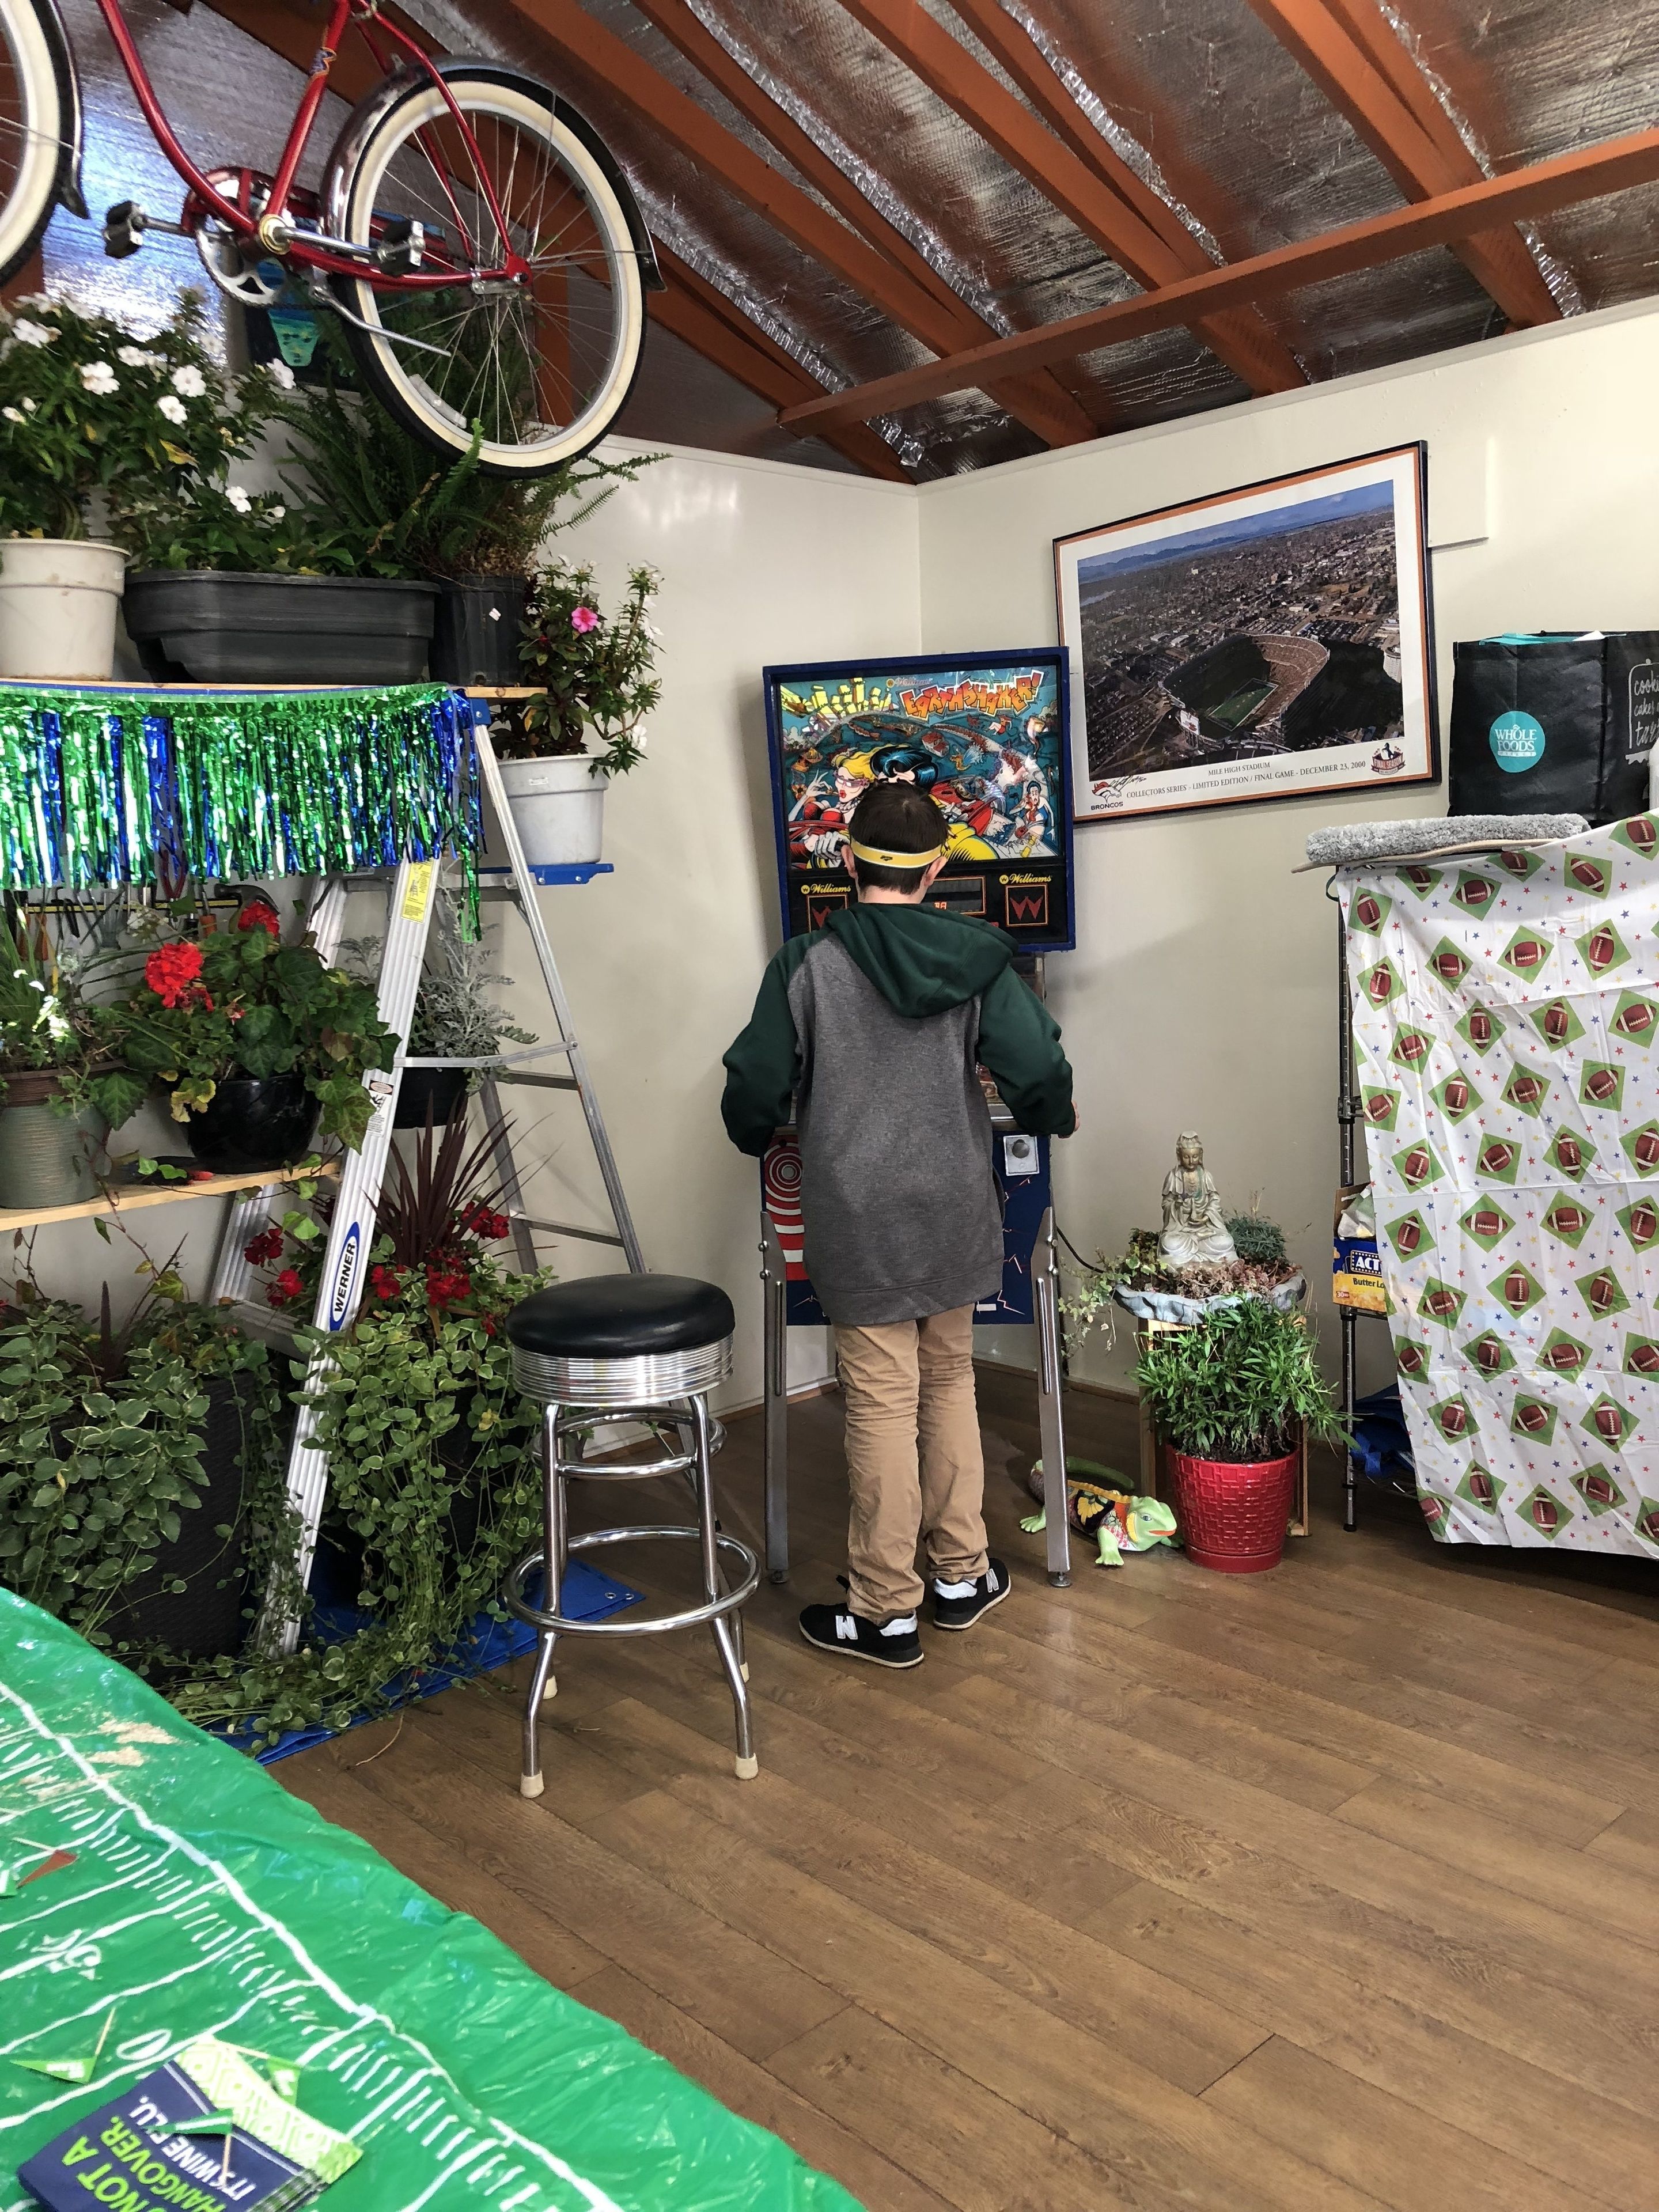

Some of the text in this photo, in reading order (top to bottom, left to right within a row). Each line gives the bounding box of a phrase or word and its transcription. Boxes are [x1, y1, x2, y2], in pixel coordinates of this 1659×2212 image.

[900, 670, 1044, 721] EARTHSHAKER!
[1494, 729, 1537, 740] WHOLE
[1497, 740, 1535, 751] FOODS
[1241, 762, 1270, 771] STADIUM
[1126, 788, 1166, 798] COLLECTORS
[1166, 785, 1187, 793] SERIES
[1192, 781, 1219, 790] LIMITED
[1221, 776, 1249, 786] EDITION
[1254, 772, 1274, 782] FINAL
[1275, 770, 1294, 779] GAME
[1300, 764, 1338, 775] DECEMBER
[1340, 763, 1349, 771] 23,
[1351, 760, 1366, 769] 2000
[1090, 801, 1123, 810] BRONCOS
[1009, 873, 1052, 884] Williams
[810, 883, 851, 893] Williams
[1355, 1256, 1380, 1271] ACT
[335, 1243, 355, 1312] WERNER
[1353, 1277, 1376, 1287] Butter
[61, 2135, 99, 2166] A
[99, 2115, 227, 2212] HANGOVER.
[161, 2135, 223, 2183] WINE
[75, 2162, 150, 2212] NOT
